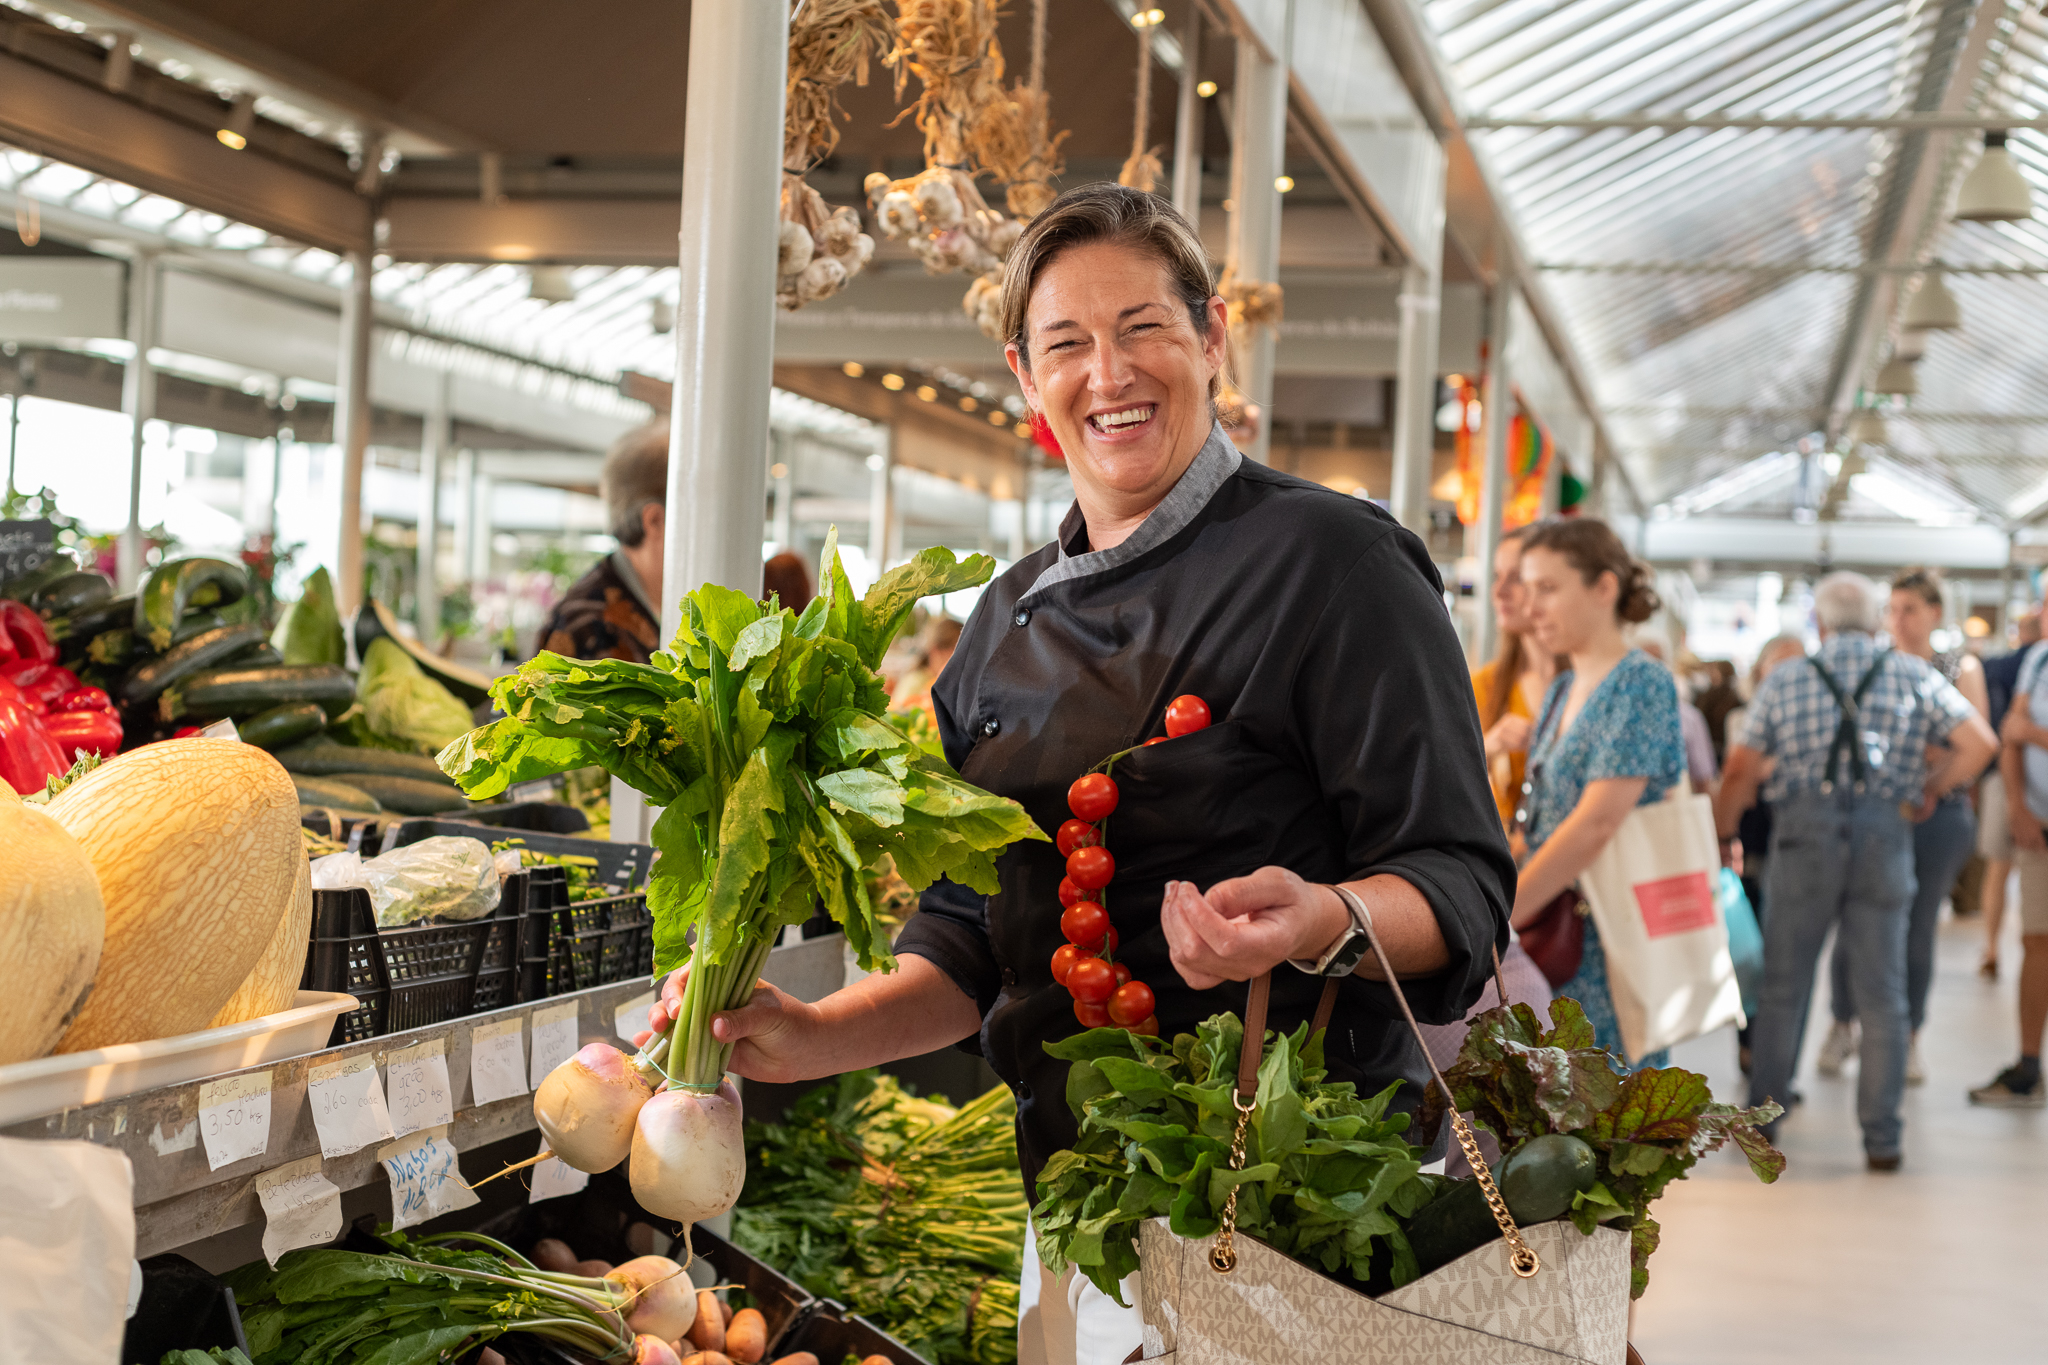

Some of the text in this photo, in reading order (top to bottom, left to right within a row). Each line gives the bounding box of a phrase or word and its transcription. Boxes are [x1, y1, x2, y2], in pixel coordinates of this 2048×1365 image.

[208, 1108, 263, 1136] 3,50 kg
[388, 1136, 436, 1188] Nabos
[1239, 1250, 1299, 1272] MK MK
[1203, 1281, 1232, 1300] MK
[1252, 1270, 1281, 1290] MK
[1281, 1274, 1310, 1293] MK
[1293, 1295, 1323, 1314] MK
[1358, 1301, 1388, 1319] MK
[1419, 1281, 1473, 1317] MK
[1473, 1278, 1526, 1312] MK
[1184, 1300, 1244, 1321] MK MK
[1307, 1315, 1438, 1336] MK MK MK MK
[1197, 1321, 1226, 1338] MK
[1228, 1322, 1257, 1341] MK
[1258, 1327, 1287, 1346] MK
[1321, 1335, 1352, 1353] MK
[1354, 1337, 1386, 1354] MK
[1388, 1337, 1419, 1354] MK
[1422, 1336, 1452, 1353] MK
[1455, 1334, 1486, 1350] MK
[1271, 1347, 1301, 1365] MK
